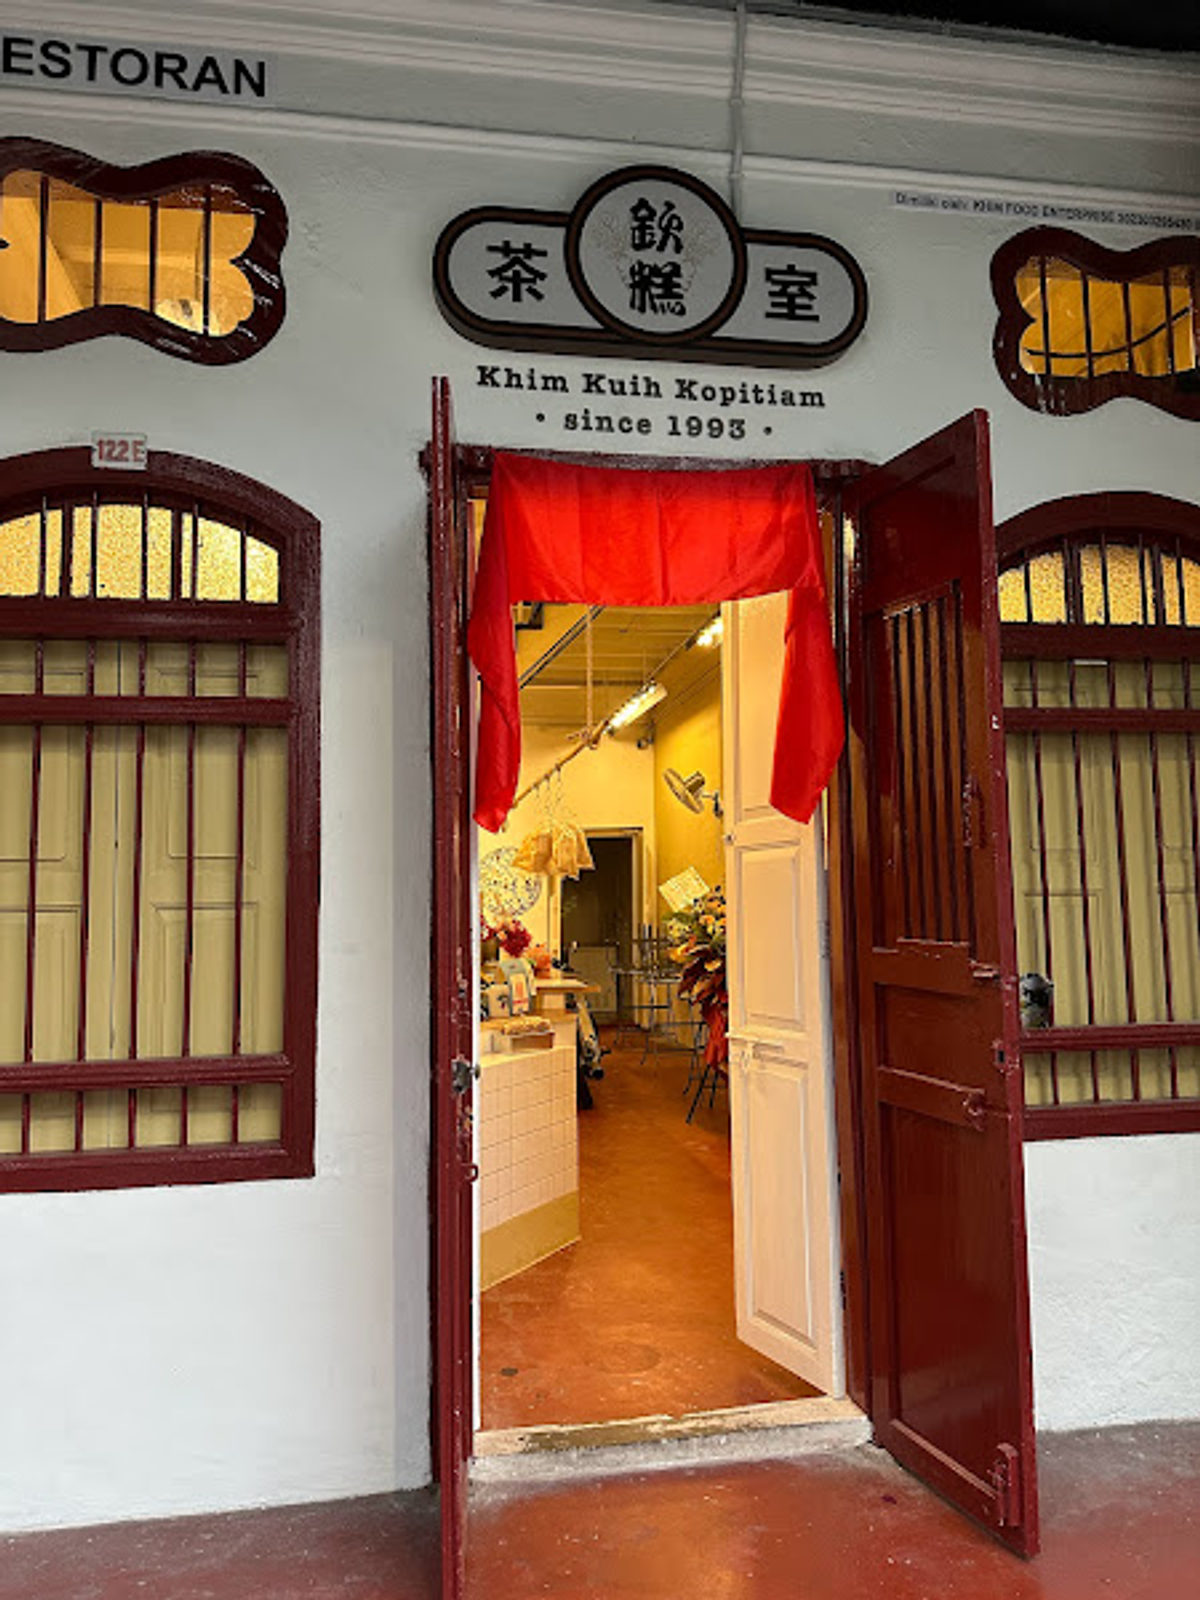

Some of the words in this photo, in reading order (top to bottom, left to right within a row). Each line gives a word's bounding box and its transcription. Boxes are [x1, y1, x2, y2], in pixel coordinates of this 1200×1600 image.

[2, 36, 266, 97] ESTORAN
[486, 240, 548, 302] 茶
[764, 264, 820, 323] 室
[476, 365, 569, 393] Khim
[581, 373, 662, 398] Kuih
[674, 378, 825, 408] Kopitiam
[564, 408, 652, 435] since
[667, 415, 746, 440] 1993
